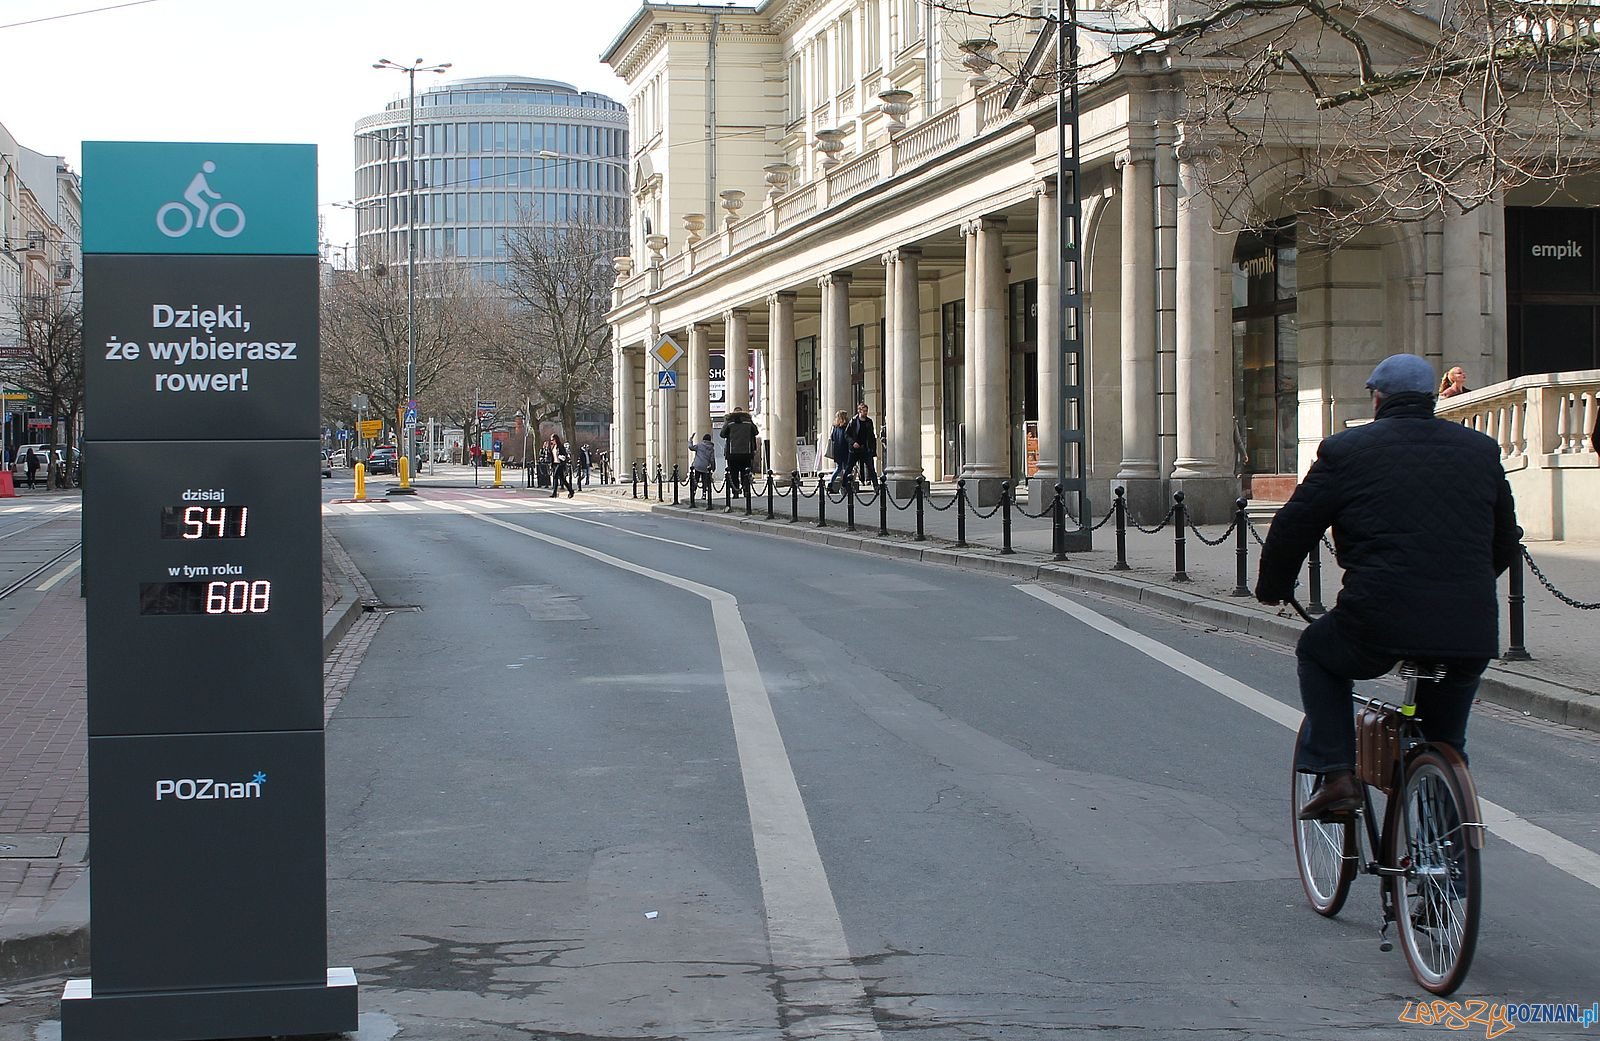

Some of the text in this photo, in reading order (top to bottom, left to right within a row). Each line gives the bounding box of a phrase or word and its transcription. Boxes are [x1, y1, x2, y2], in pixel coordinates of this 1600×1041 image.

[1531, 242, 1582, 266] empik
[152, 304, 251, 333] Dzięki,
[105, 336, 297, 366] że wybierasz
[155, 368, 248, 392] rower!
[182, 489, 225, 503] dzisiaj
[182, 507, 248, 538] 541
[168, 564, 242, 577] w tym roku
[206, 580, 271, 614] 608
